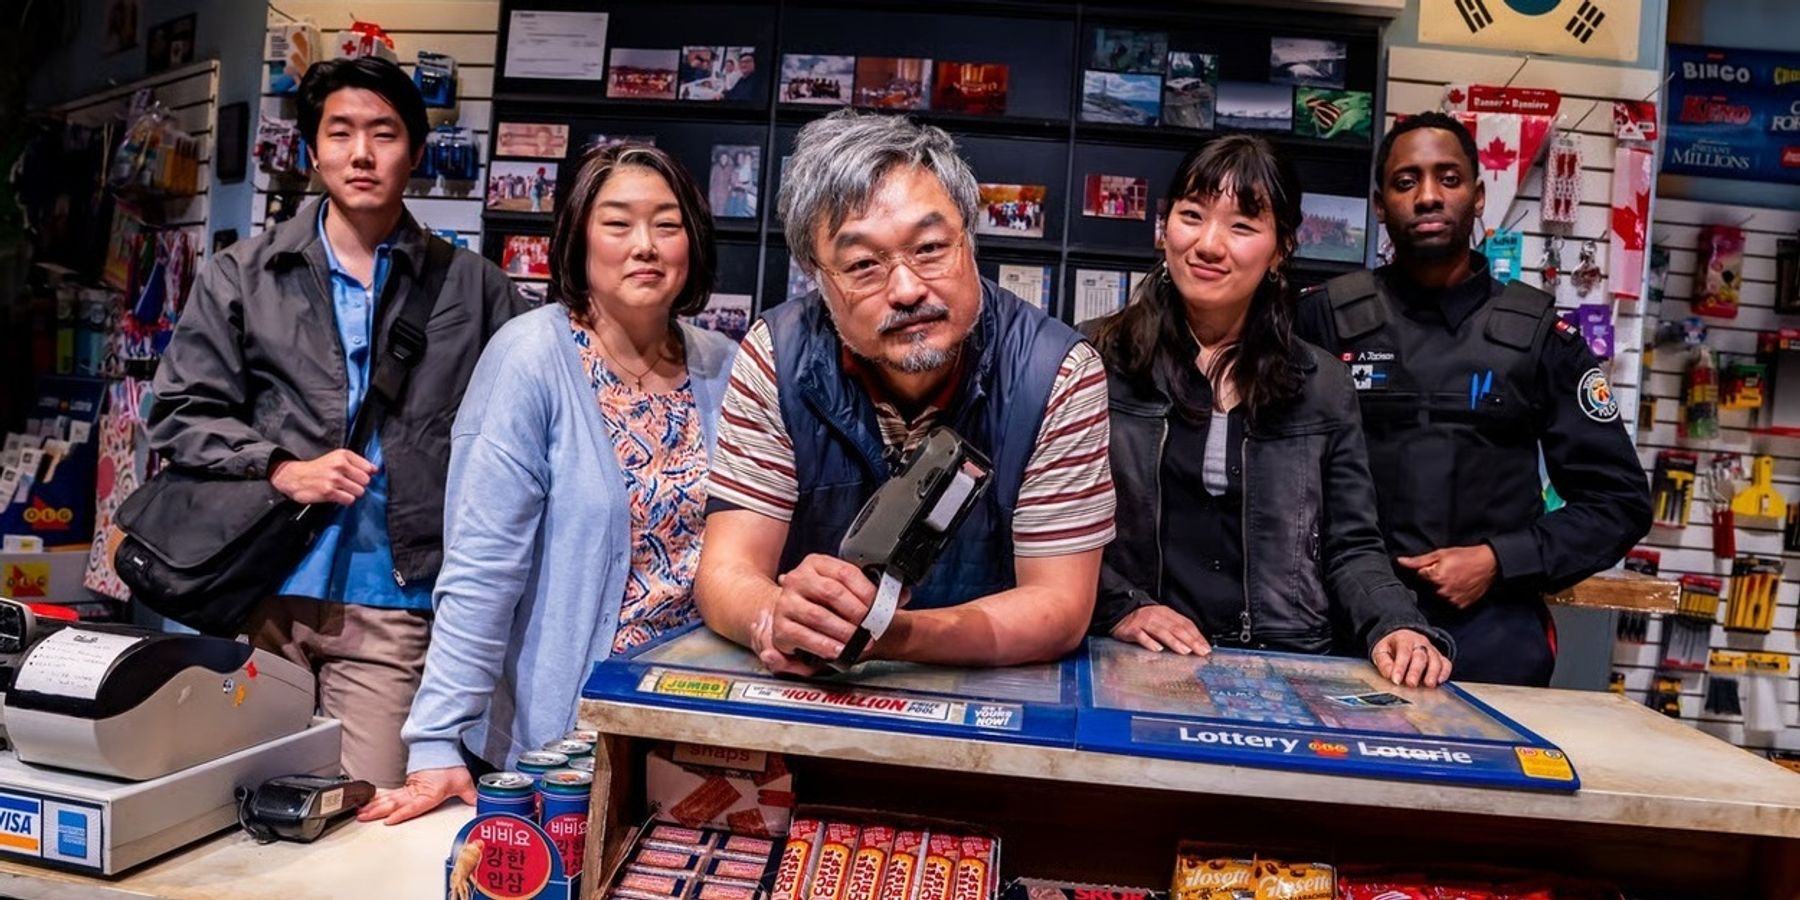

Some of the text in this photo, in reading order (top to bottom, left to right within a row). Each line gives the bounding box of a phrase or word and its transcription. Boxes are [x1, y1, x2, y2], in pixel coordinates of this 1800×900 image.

[1682, 61, 1750, 83] BINGO
[1672, 148, 1750, 169] MILLIONS
[667, 680, 722, 691] JUMBO
[781, 688, 906, 712] $100 MILLION
[976, 717, 1010, 727] NOW!
[1179, 727, 1299, 753] Lottery
[1357, 741, 1473, 764] Loterie
[481, 825, 531, 846] 비비요
[487, 846, 527, 871] 강한
[487, 871, 524, 894] 인삼
[783, 855, 801, 892] CRISP
[813, 849, 835, 896] COFFEE
[823, 858, 842, 897] CRISP
[857, 864, 877, 900] CRISP
[892, 868, 906, 900] RISP
